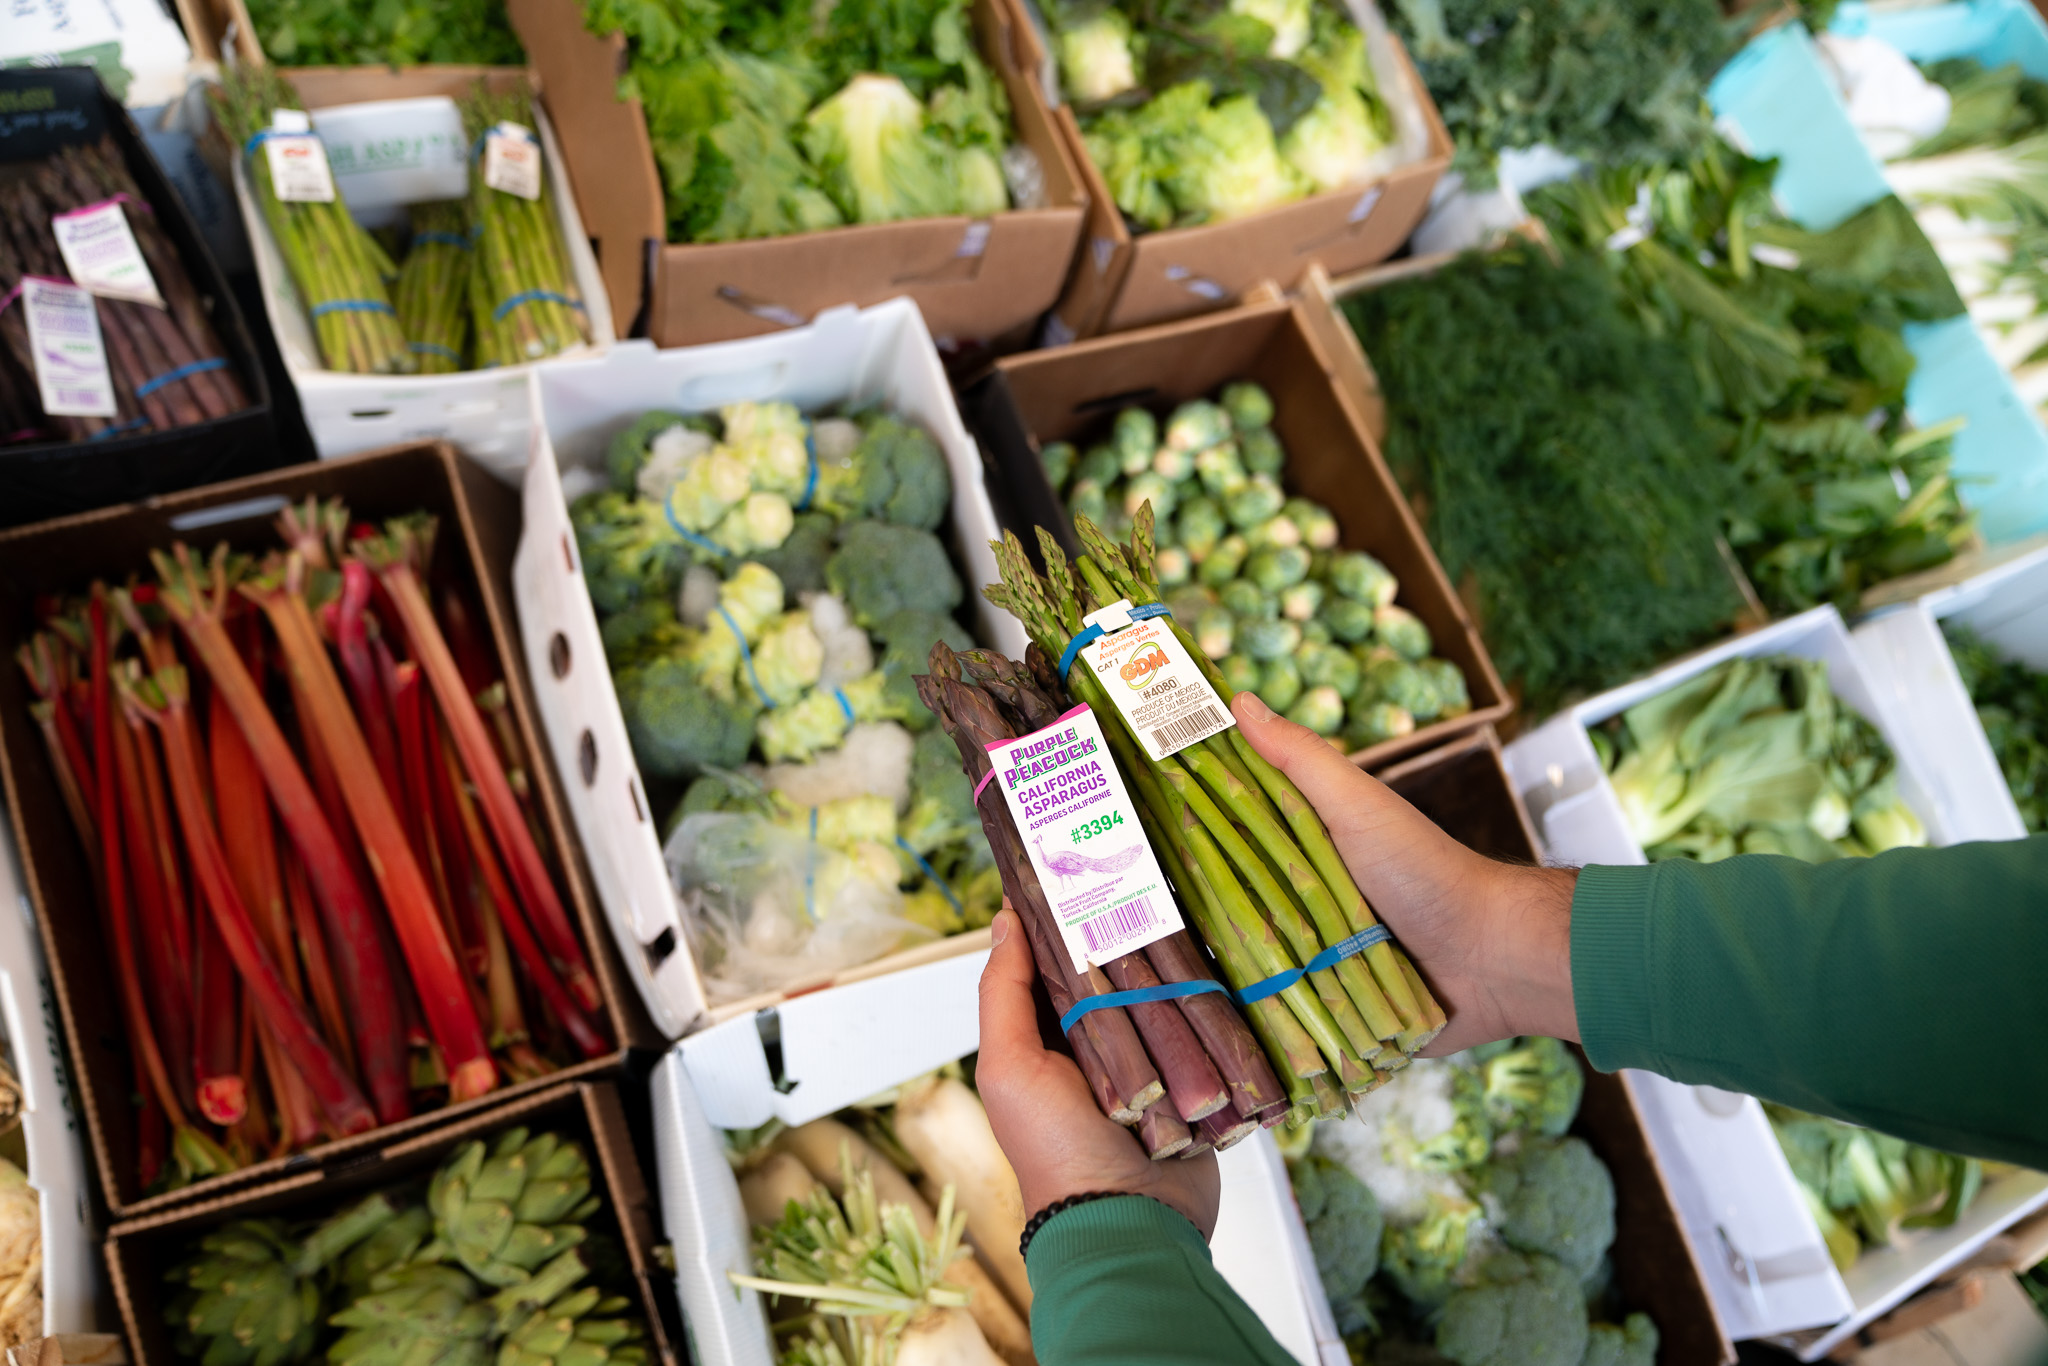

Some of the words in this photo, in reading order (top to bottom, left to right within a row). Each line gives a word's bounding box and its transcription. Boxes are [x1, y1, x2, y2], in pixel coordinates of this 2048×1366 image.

[1099, 640, 1135, 660] Asperges
[1135, 630, 1160, 643] Vertes
[1101, 624, 1149, 650] Asparagus
[1097, 661, 1113, 673] CAT
[1120, 649, 1171, 681] GDM
[1131, 698, 1165, 718] PRODUCE
[1164, 693, 1174, 703] OF
[1174, 681, 1201, 698] MEXICO
[1135, 706, 1165, 725] PRODUIT
[1165, 702, 1176, 712] DU
[1175, 688, 1207, 707] MEXIQUE
[1143, 679, 1178, 700] #4080
[1003, 736, 1098, 791] PEACOCK
[1009, 727, 1079, 768] PURPLE
[1017, 760, 1102, 804] CALIFORNIA
[1024, 773, 1107, 820] ASPARAGUS
[1029, 808, 1068, 831] ASPERGES
[1067, 789, 1112, 814] CALIFORNIE
[1070, 810, 1124, 845] #3394
[1057, 892, 1086, 909] Distributed
[1114, 876, 1123, 884] par
[1060, 902, 1079, 914] Turlock
[1079, 896, 1091, 906] Fruit
[1064, 913, 1090, 928] PRODUCE
[1089, 909, 1097, 917] OF
[1136, 887, 1147, 896] DES
[1146, 883, 1158, 892] E.U.
[1082, 897, 1107, 911] California
[1097, 937, 1124, 953] 50012
[1125, 923, 1152, 941] 00291
